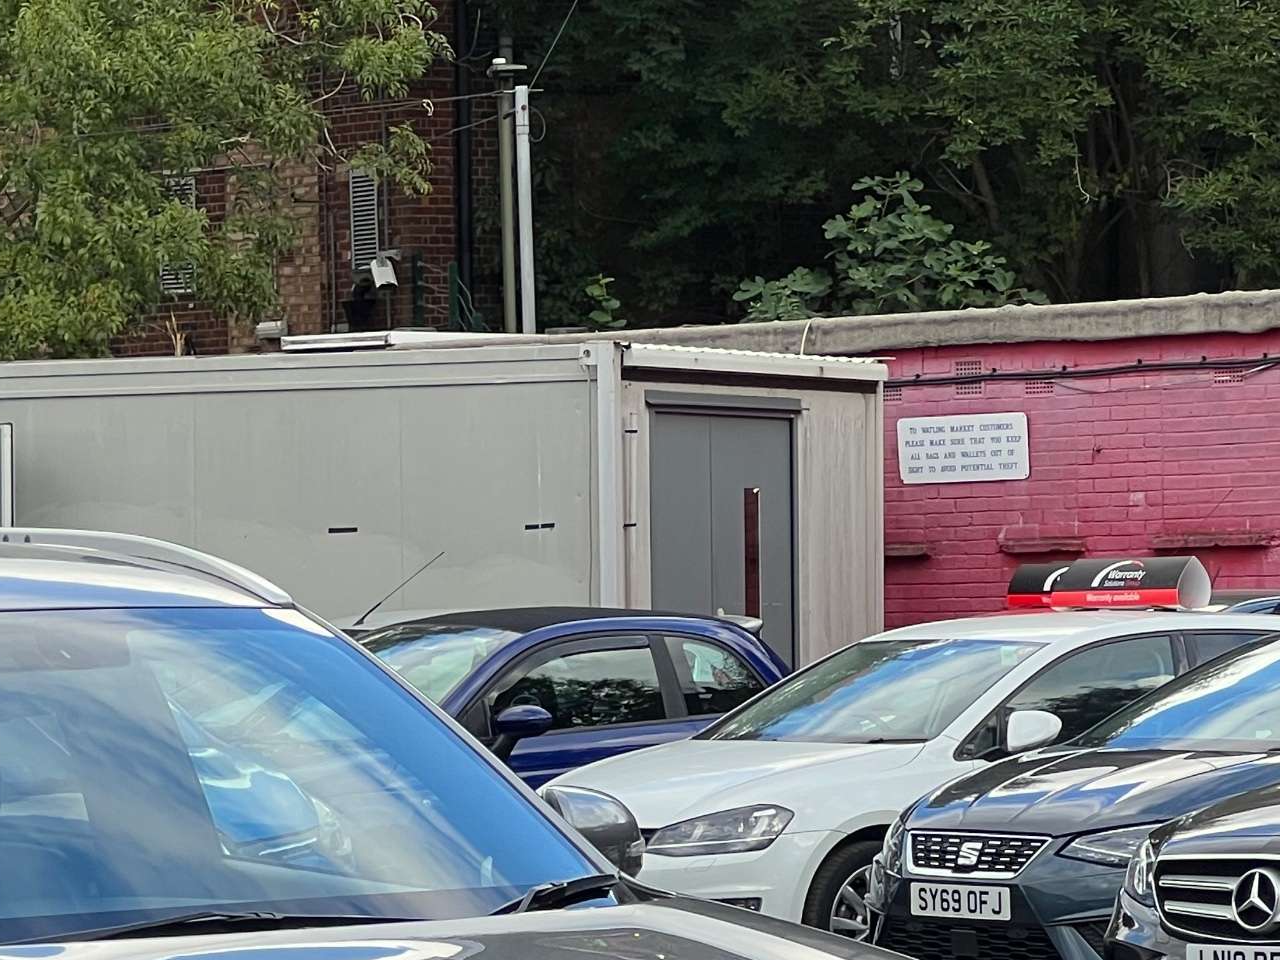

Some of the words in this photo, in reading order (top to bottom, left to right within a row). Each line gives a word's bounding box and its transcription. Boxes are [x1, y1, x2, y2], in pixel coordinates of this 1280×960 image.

[950, 424, 974, 433] MARKET
[979, 423, 1013, 431] CUSTOMERS
[1006, 435, 1021, 443] KEEP
[910, 452, 921, 460] ALL
[944, 451, 956, 459] AND
[998, 462, 1018, 470] THEFT
[1107, 570, 1146, 580] Warranty
[918, 887, 962, 913] SY69
[967, 890, 1002, 915] OFJ
